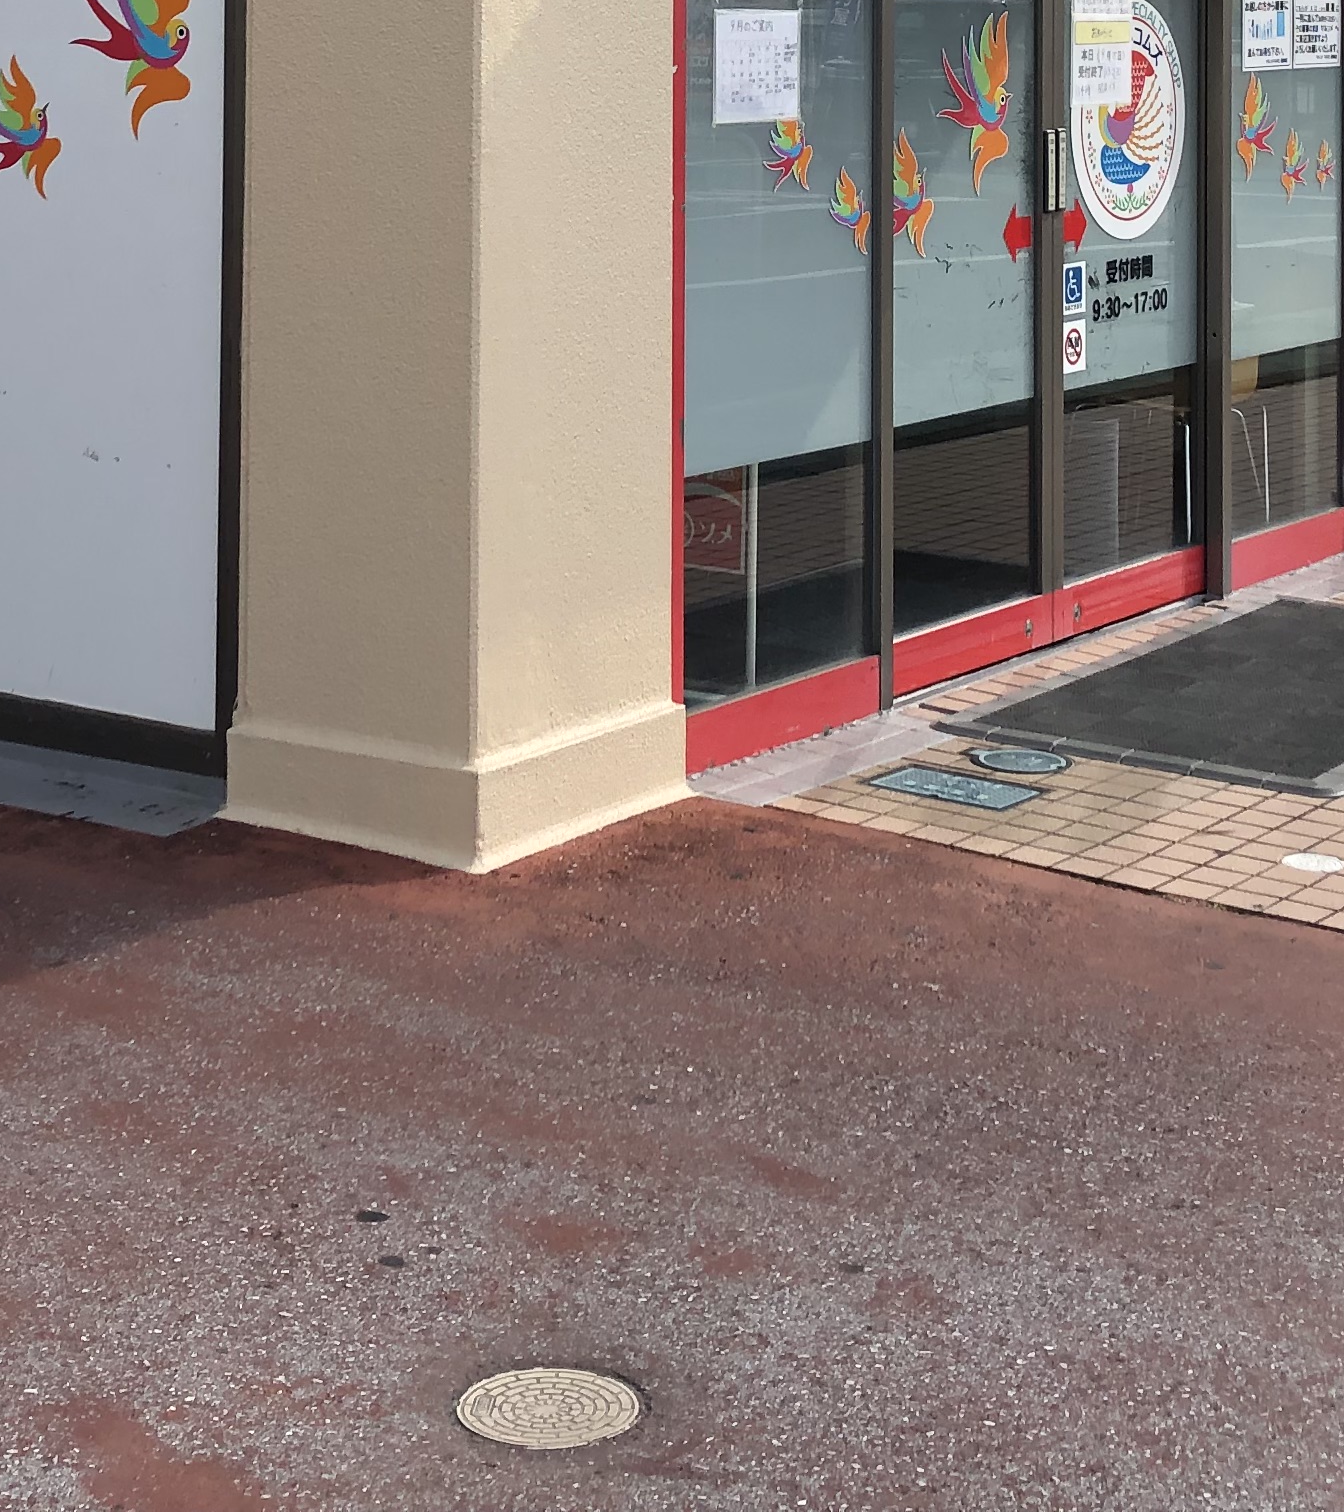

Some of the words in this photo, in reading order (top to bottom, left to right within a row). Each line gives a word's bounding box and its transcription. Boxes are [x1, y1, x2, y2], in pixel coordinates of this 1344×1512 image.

[1166, 40, 1182, 89] SHOP
[1106, 255, 1154, 284] 受付時間
